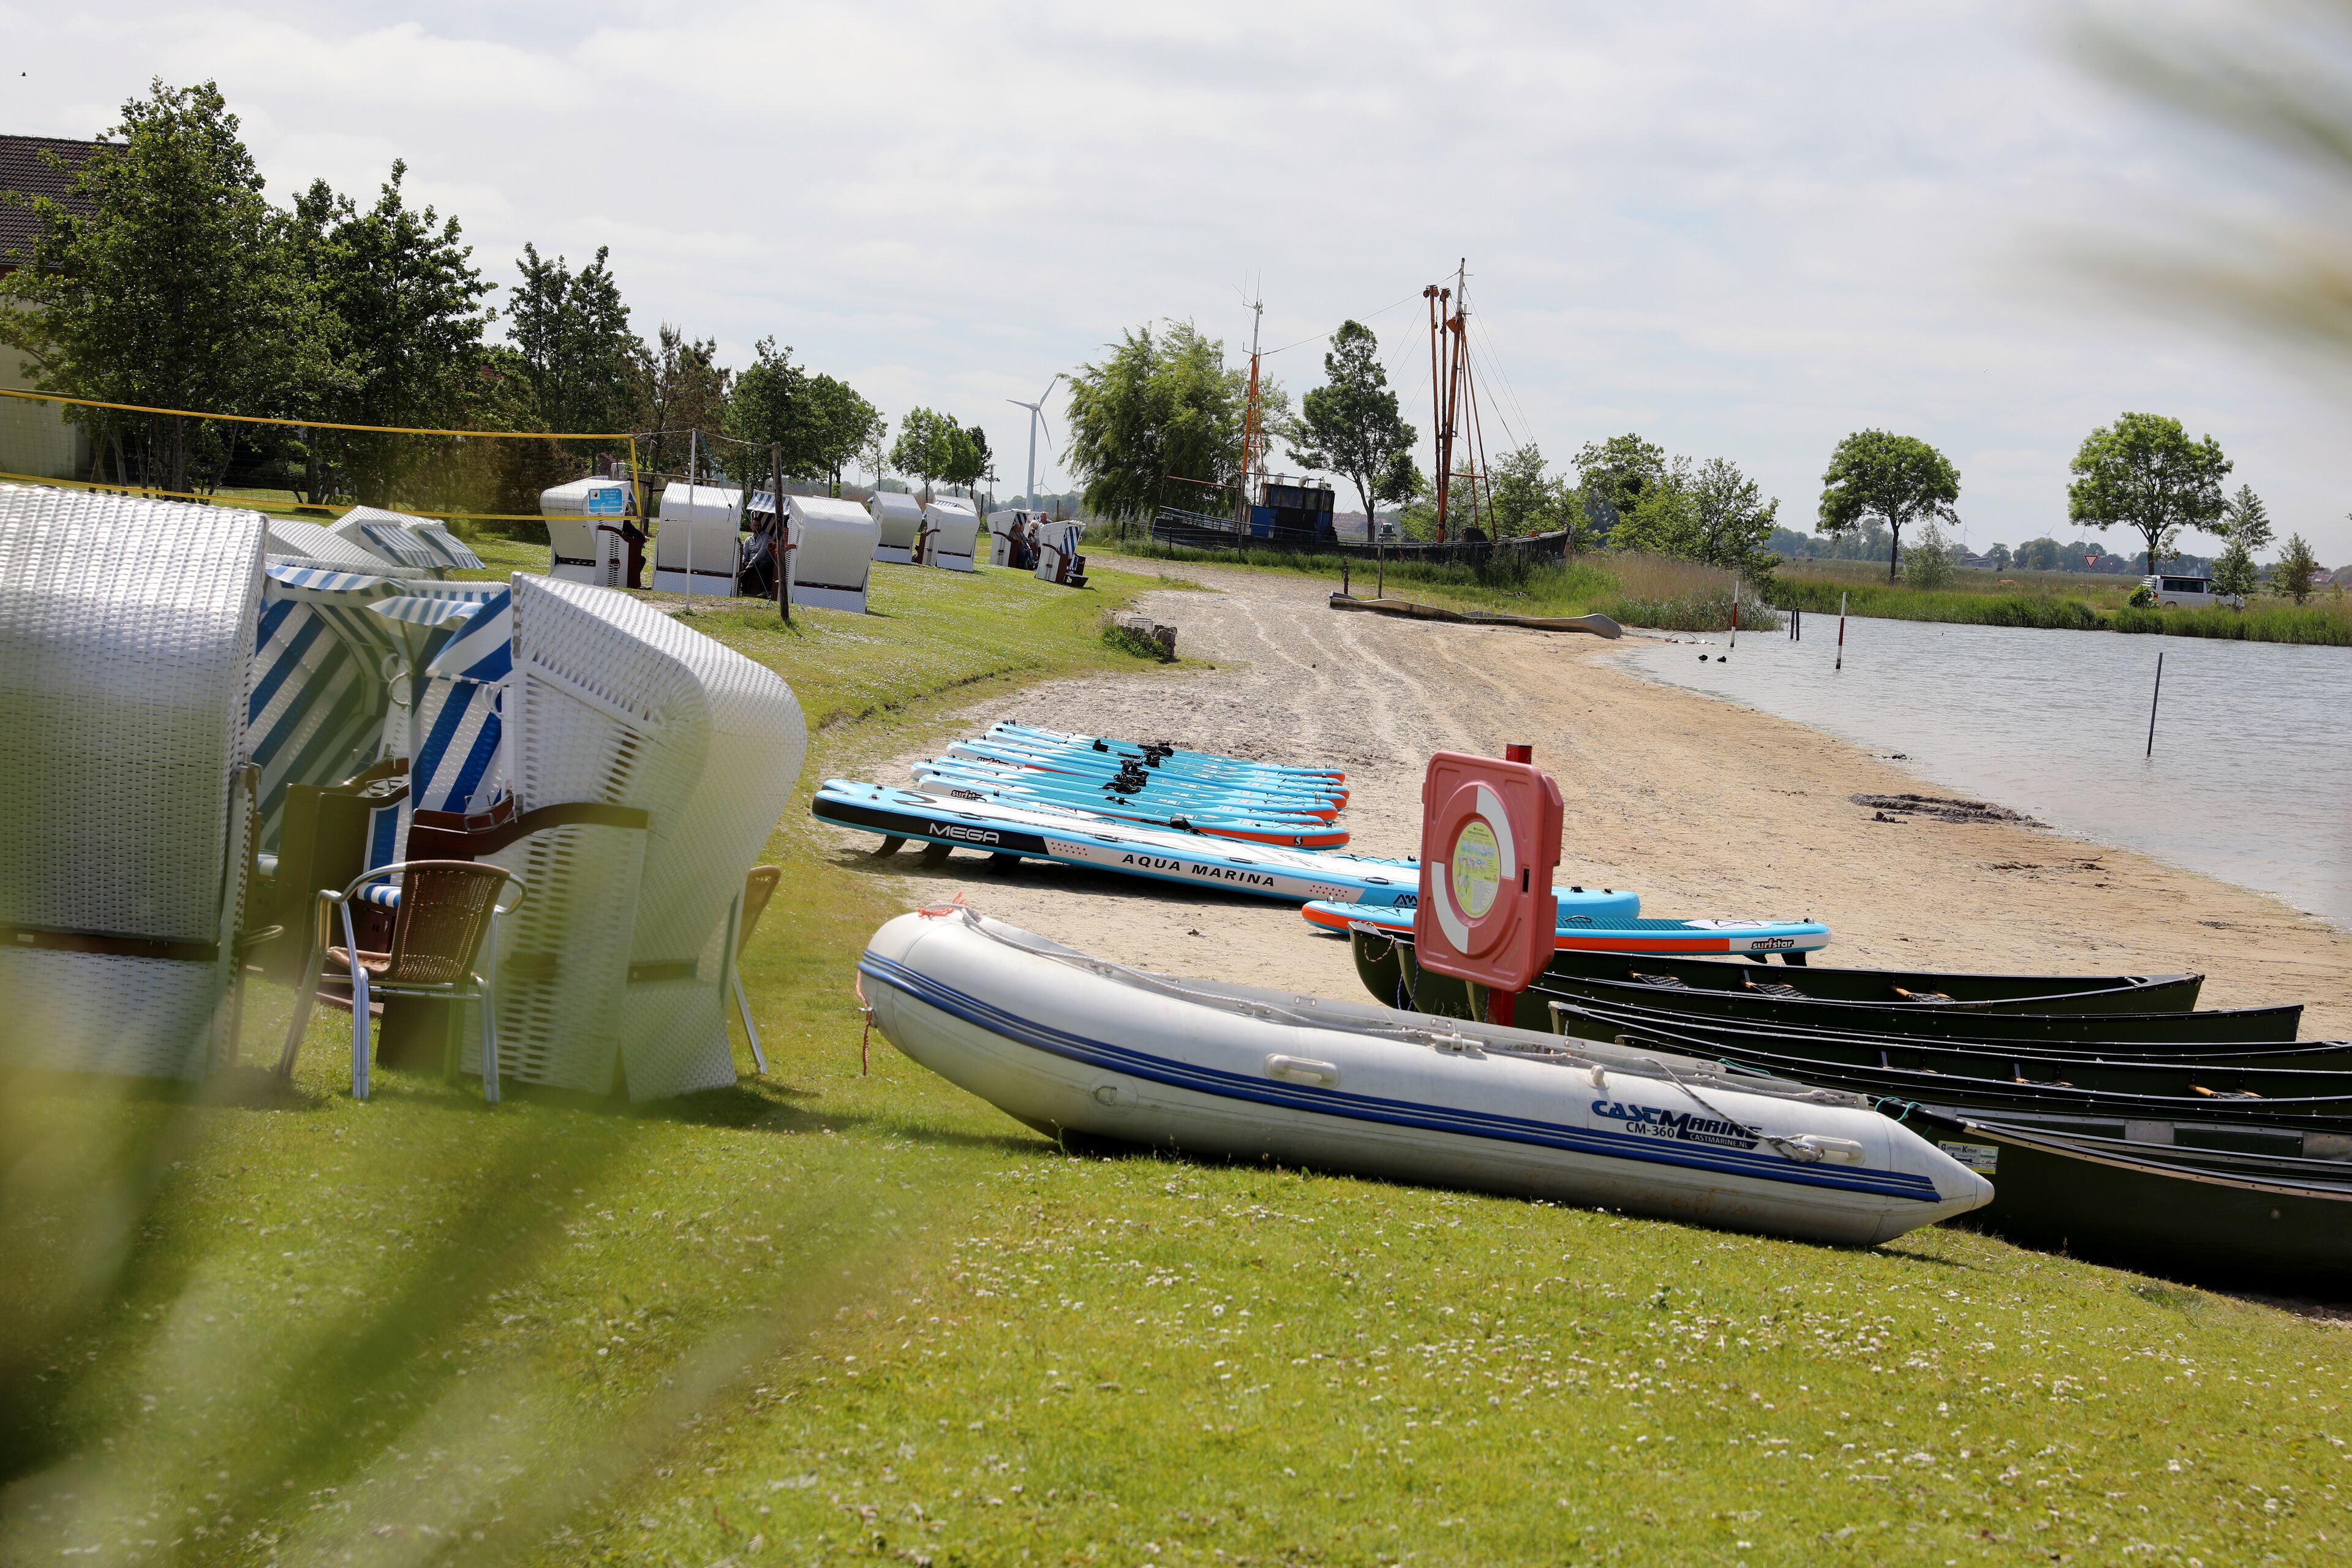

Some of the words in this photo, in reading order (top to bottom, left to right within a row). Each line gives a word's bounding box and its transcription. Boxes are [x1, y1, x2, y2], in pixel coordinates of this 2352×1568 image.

[929, 823, 1000, 844] MEGA
[1122, 854, 1180, 871] AQUA
[1191, 864, 1274, 887] MARINA
[1752, 938, 1793, 949] surfstar
[1626, 1121, 1675, 1138] CM-360
[1690, 1134, 1749, 1148] CASTMARINE.NL
